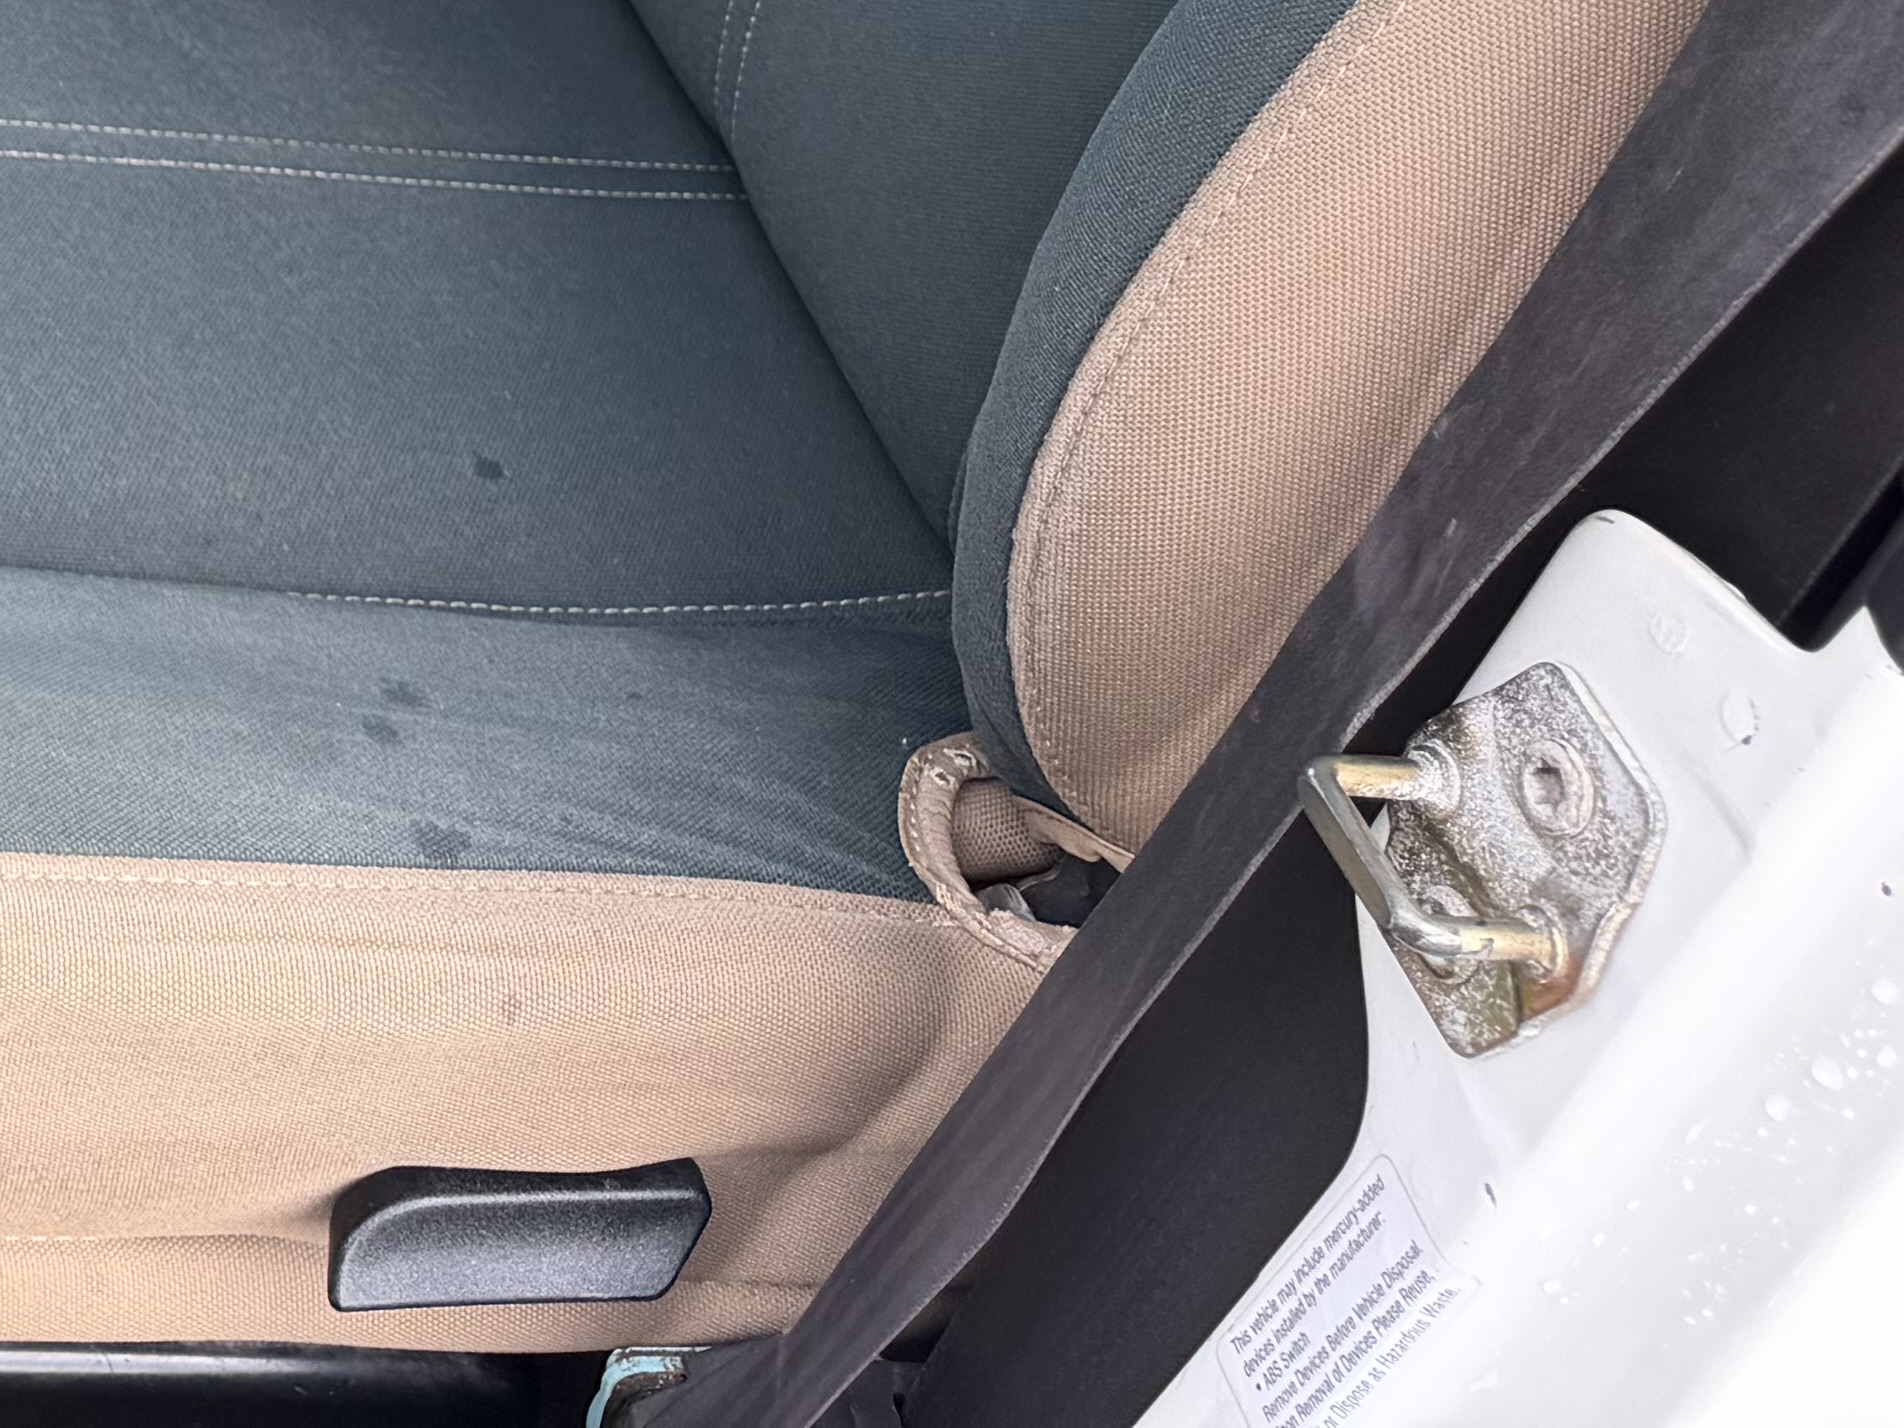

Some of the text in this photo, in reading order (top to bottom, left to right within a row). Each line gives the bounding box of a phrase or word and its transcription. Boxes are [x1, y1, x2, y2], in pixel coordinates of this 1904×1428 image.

[1231, 1173, 1385, 1354] This vehicle may include mercury-added
[1243, 1338, 1275, 1377] devices
[1271, 1296, 1307, 1345] installed
[1303, 1290, 1317, 1307] by
[1314, 1273, 1331, 1296] the
[1261, 1381, 1298, 1423] Remove
[1295, 1346, 1330, 1388] Devices
[1325, 1315, 1357, 1353] Before
[1352, 1281, 1386, 1322] Vehicle
[1263, 1332, 1311, 1391] ABS Switch
[1295, 1375, 1336, 1422] Removal
[1332, 1362, 1344, 1383] of
[1341, 1331, 1378, 1372] Devices
[1372, 1298, 1406, 1337] Please
[1376, 1317, 1432, 1369] Hazardous
[1330, 1380, 1373, 1419] Dispose
[1369, 1366, 1386, 1382] as
